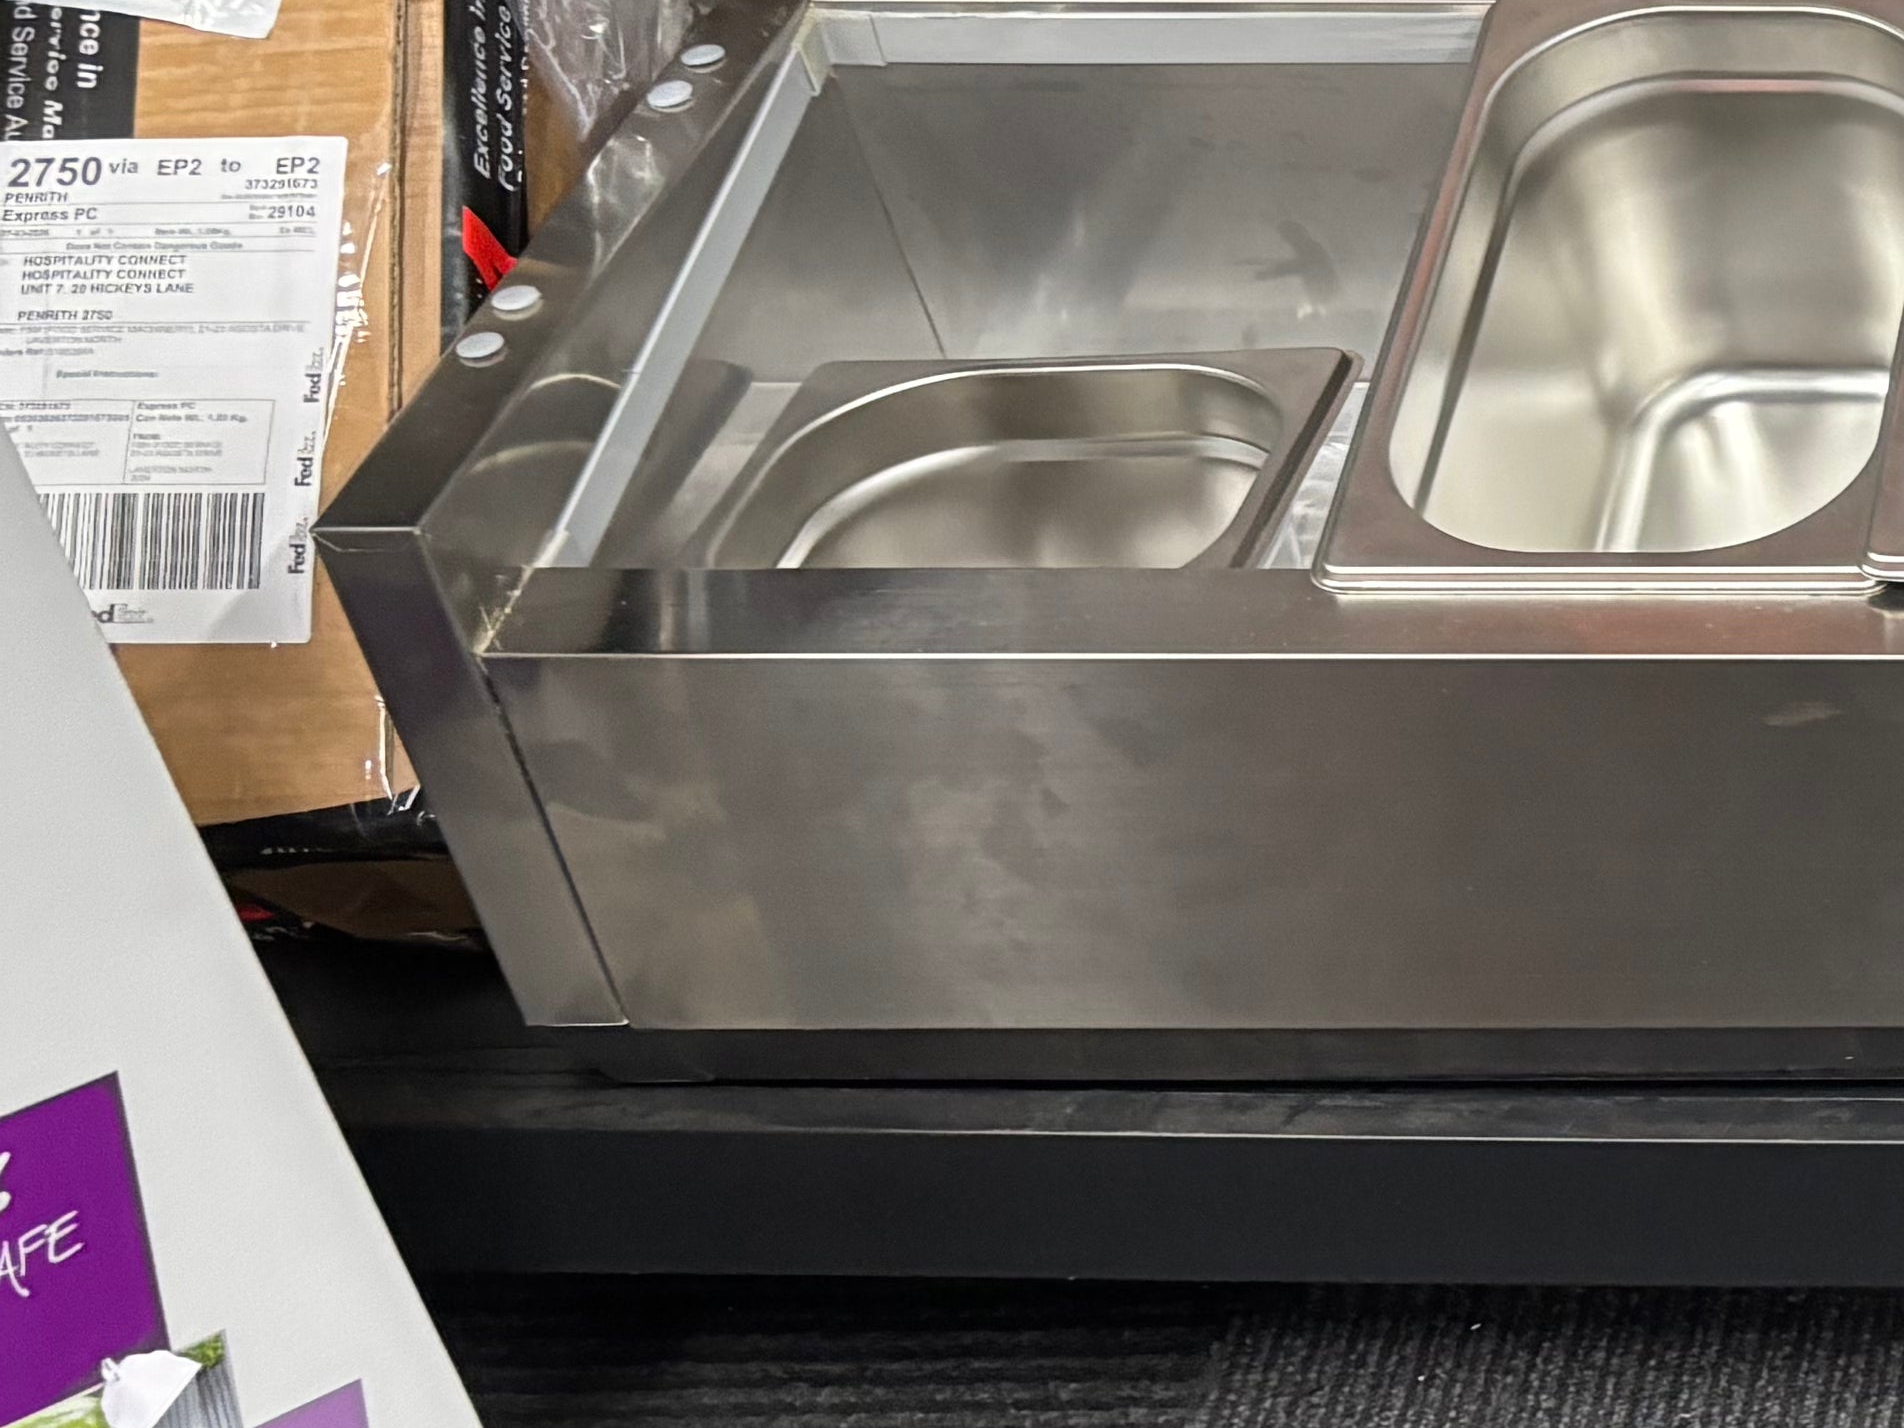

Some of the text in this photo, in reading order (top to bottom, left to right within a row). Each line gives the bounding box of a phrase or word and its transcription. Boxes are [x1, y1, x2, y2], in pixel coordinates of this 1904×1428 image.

[6, 26, 35, 109] Service
[494, 5, 513, 112] Service
[76, 63, 104, 88] in
[471, 25, 491, 180] Excellence
[8, 156, 321, 188] 2750 via EP2 to EP2
[4, 192, 68, 203] PENRITH
[2, 209, 69, 223] Express
[74, 208, 98, 220] PC
[267, 205, 316, 219] 29104
[24, 255, 187, 266] HOSPITALITY CONNECT
[22, 269, 186, 280] HOSPITALITY CONNECT
[21, 283, 52, 294] UNIT
[91, 283, 152, 294] HICKEYS
[156, 283, 195, 294] LANE
[17, 310, 78, 321] PENRITH
